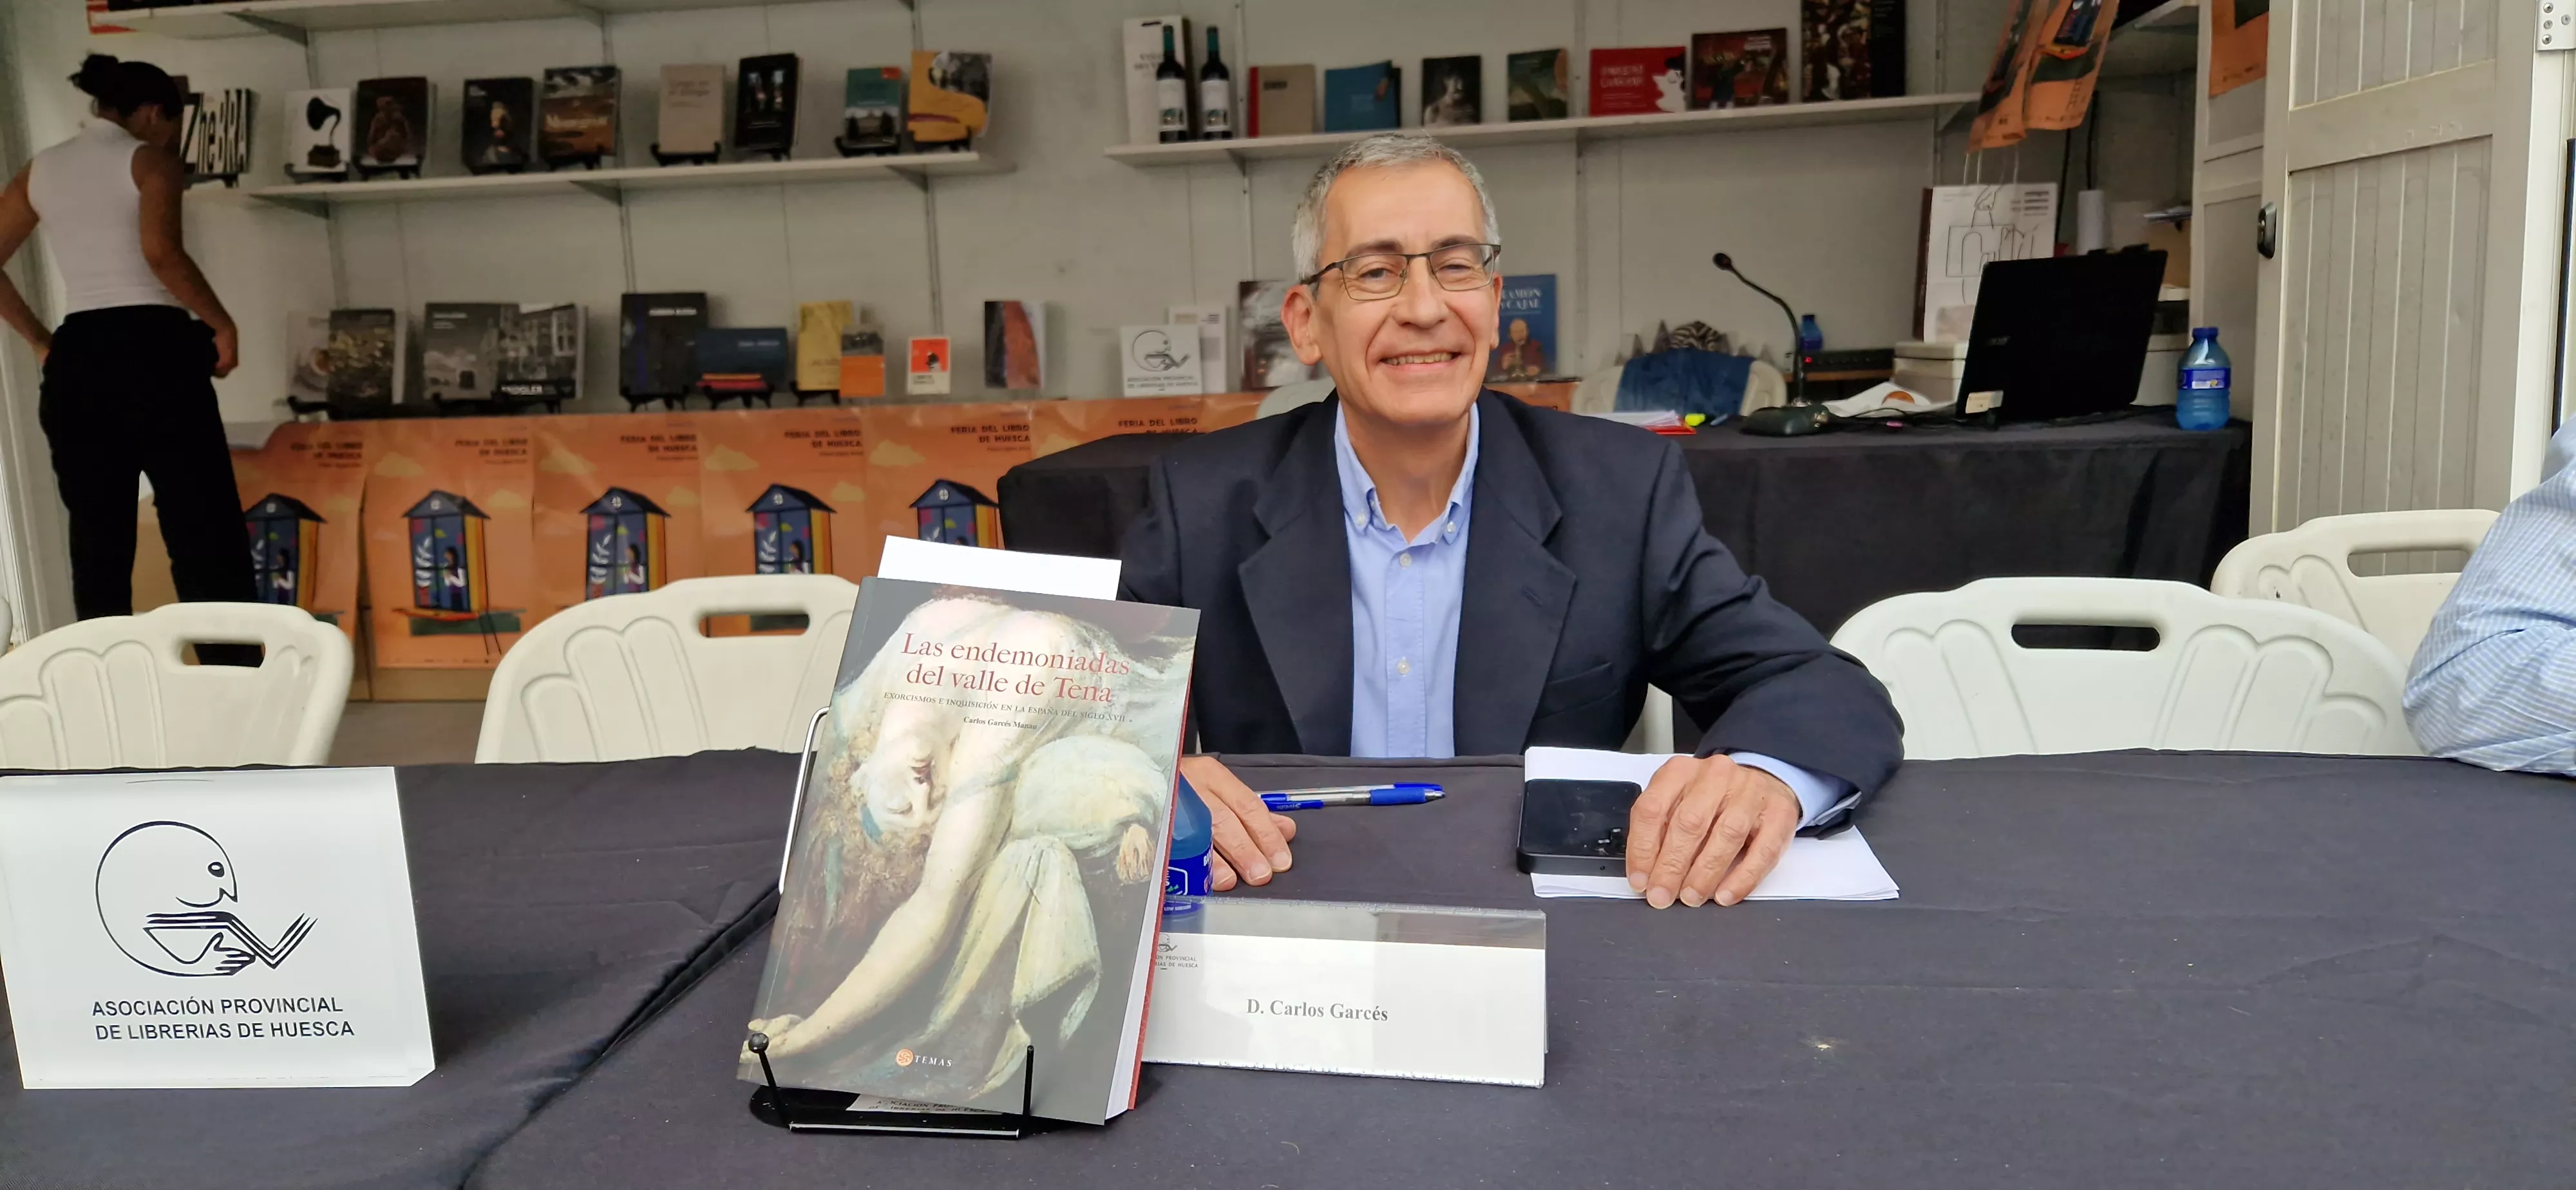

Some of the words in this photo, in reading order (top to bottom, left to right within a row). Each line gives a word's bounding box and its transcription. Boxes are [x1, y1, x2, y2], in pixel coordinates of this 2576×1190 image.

[994, 434, 1030, 442] HUESCA
[901, 632, 943, 657] Las
[951, 642, 1131, 675] endemoniadas
[906, 663, 944, 686] del
[951, 669, 1009, 692] valle
[1015, 674, 1046, 696] de
[1054, 676, 1113, 703] Tena
[884, 692, 936, 704] EXORCISMOS
[946, 699, 998, 710] INQUISICIÓN
[1028, 706, 1059, 716] ESPAÑA
[1106, 714, 1126, 722] XVII
[963, 716, 986, 725] Carlos
[987, 719, 1012, 728] Garcés
[1013, 721, 1037, 730] Manau
[92, 996, 214, 1017] ASOCIACIÓN
[220, 997, 344, 1015] PROVINCIAL
[1246, 999, 1264, 1015] D.
[1269, 1000, 1324, 1017] Carlos
[1330, 1003, 1388, 1021] Garcés
[95, 1025, 122, 1040] DE
[128, 1023, 232, 1040] LIBRERIAS
[238, 1023, 265, 1038] DE
[270, 1021, 355, 1037] HUESCA
[914, 1055, 952, 1067] TEMAS
